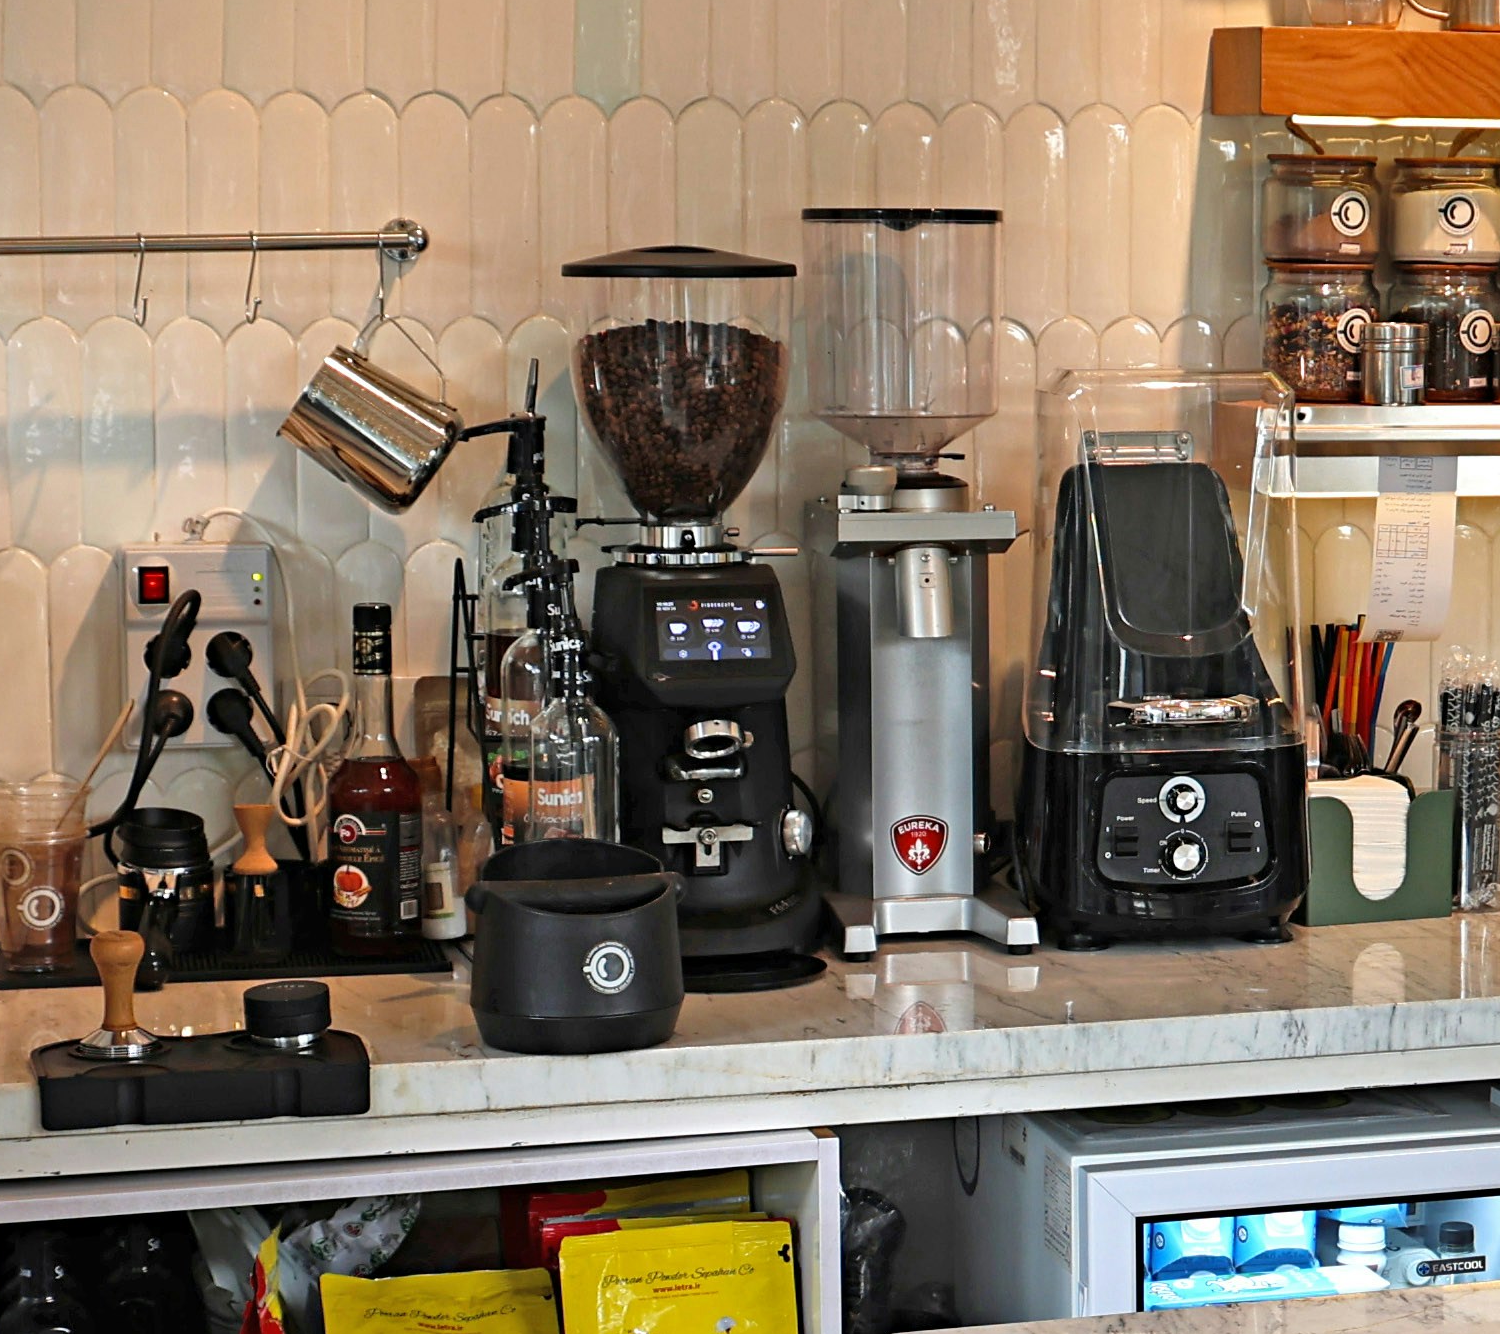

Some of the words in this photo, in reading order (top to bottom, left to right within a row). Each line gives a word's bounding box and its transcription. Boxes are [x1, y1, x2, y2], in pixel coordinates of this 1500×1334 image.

[1137, 797, 1157, 805] Speed
[897, 820, 940, 835] EUREKA
[1432, 1260, 1483, 1273] EASTCOOL
[652, 1282, 700, 1295] www.letra.ir
[417, 1320, 463, 1332] www.letra.ir
